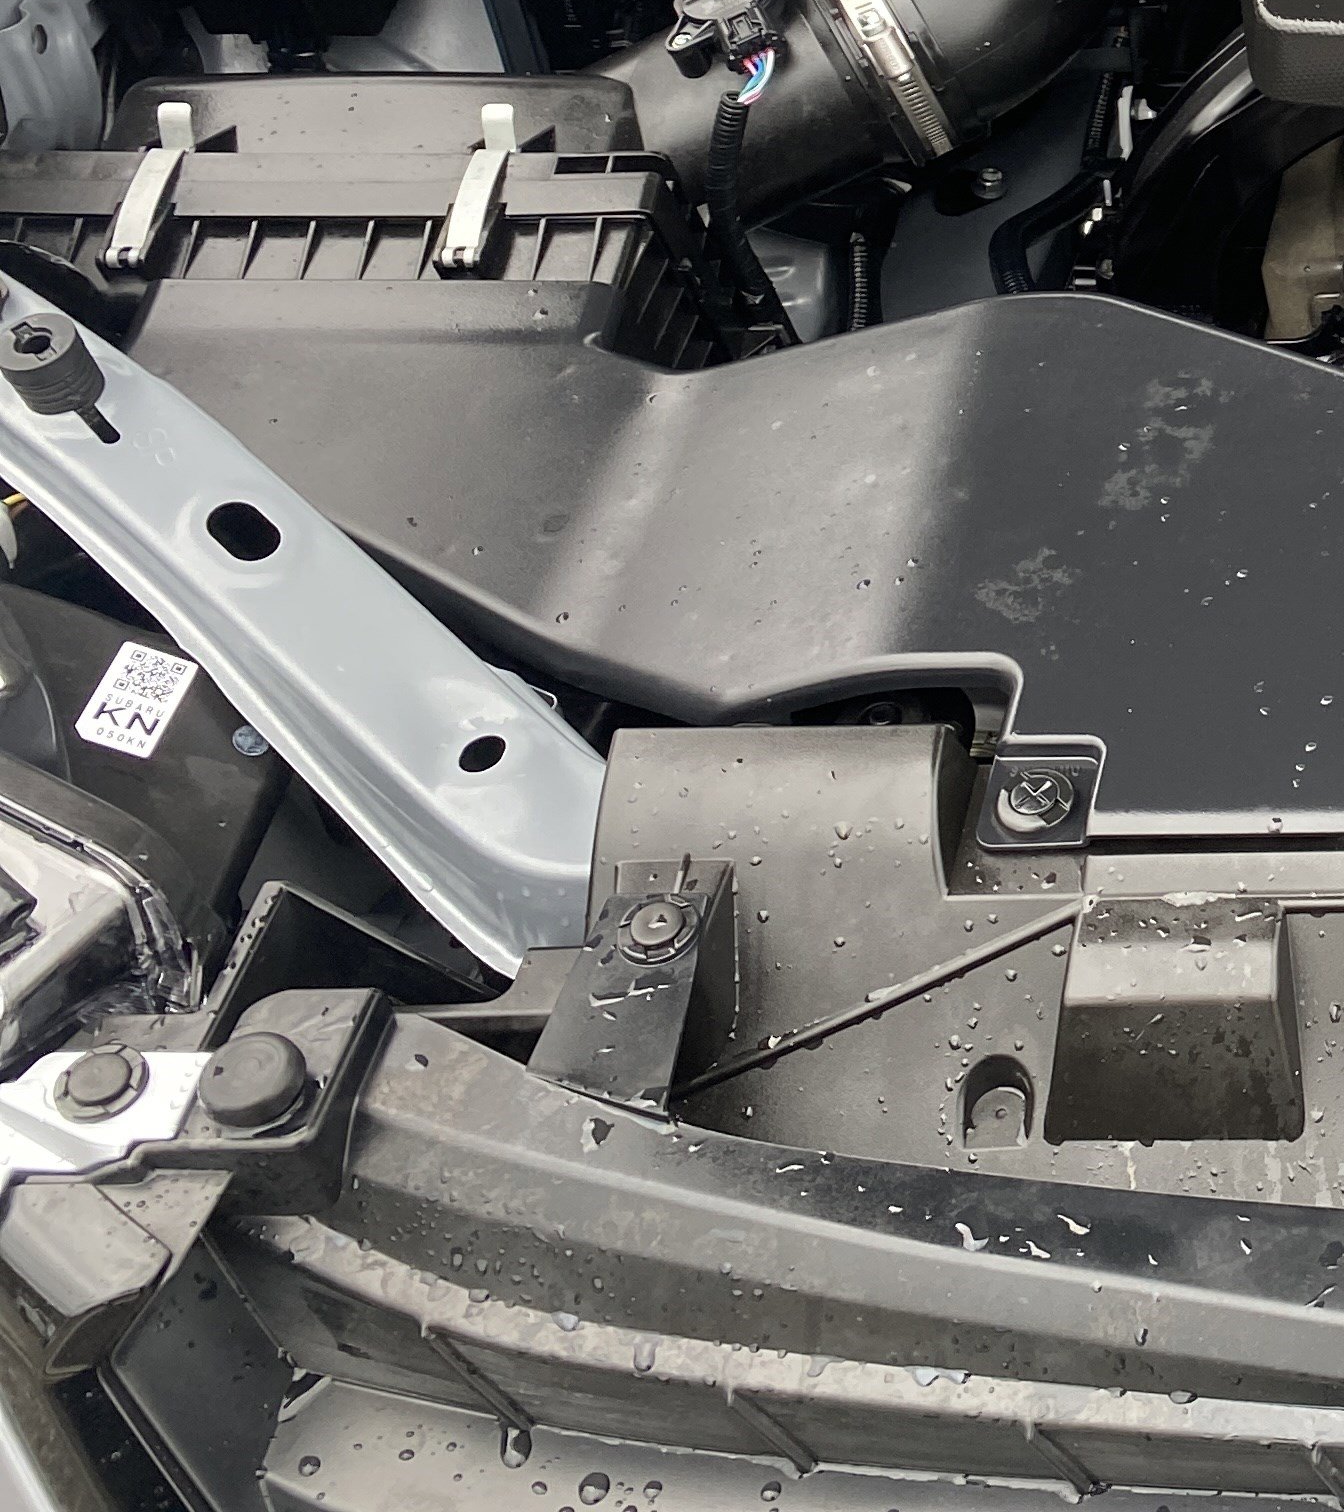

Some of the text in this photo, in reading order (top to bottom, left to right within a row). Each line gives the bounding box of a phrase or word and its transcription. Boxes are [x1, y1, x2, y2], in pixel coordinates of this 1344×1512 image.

[106, 694, 164, 718] SUBARU
[94, 701, 159, 737] KN
[95, 726, 146, 749] 050KN
